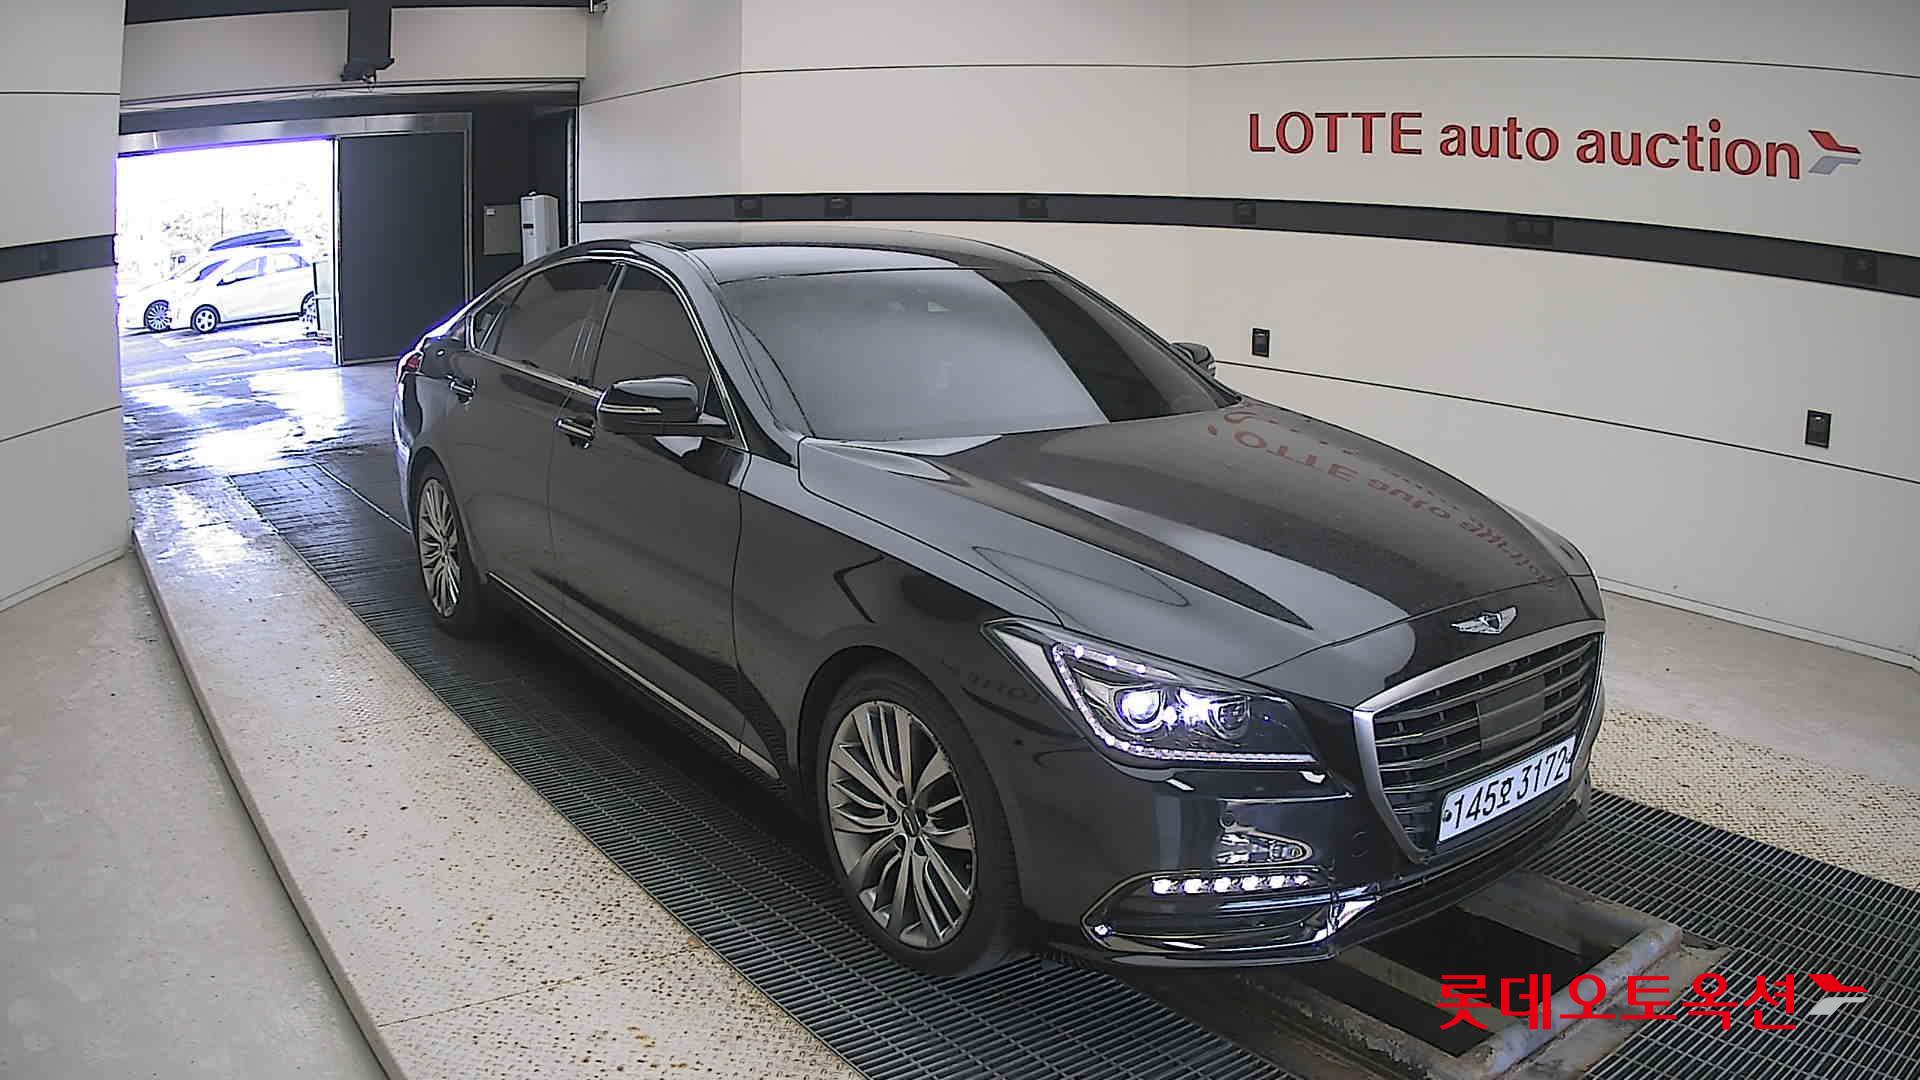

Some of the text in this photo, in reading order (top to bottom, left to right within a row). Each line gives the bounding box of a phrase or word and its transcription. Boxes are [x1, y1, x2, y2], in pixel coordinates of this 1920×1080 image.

[1248, 111, 1801, 179] LOTTE auto auction
[1516, 746, 1568, 800] 3172
